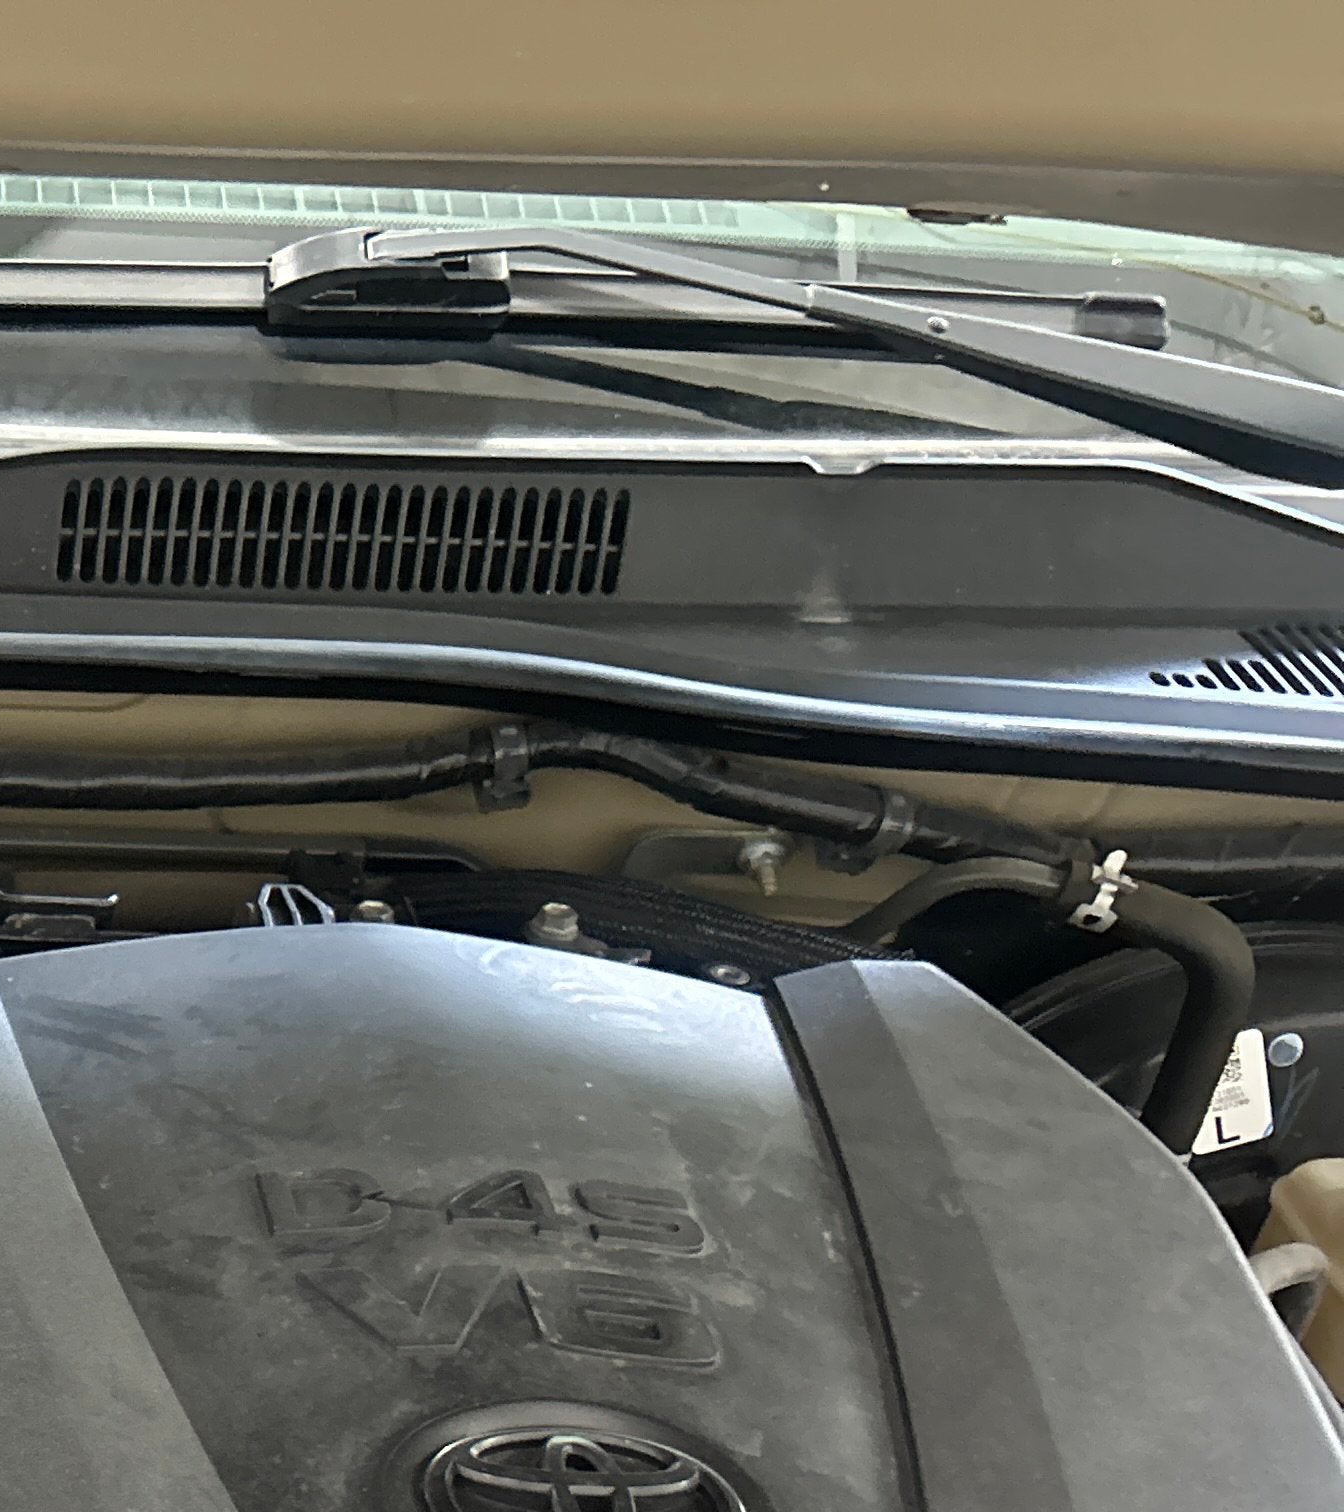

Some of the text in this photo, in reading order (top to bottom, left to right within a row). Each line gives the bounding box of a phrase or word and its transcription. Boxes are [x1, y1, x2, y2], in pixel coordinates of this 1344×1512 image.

[1214, 1116, 1241, 1145] L
[254, 1167, 717, 1258] D-4S
[296, 1265, 721, 1372] V6
